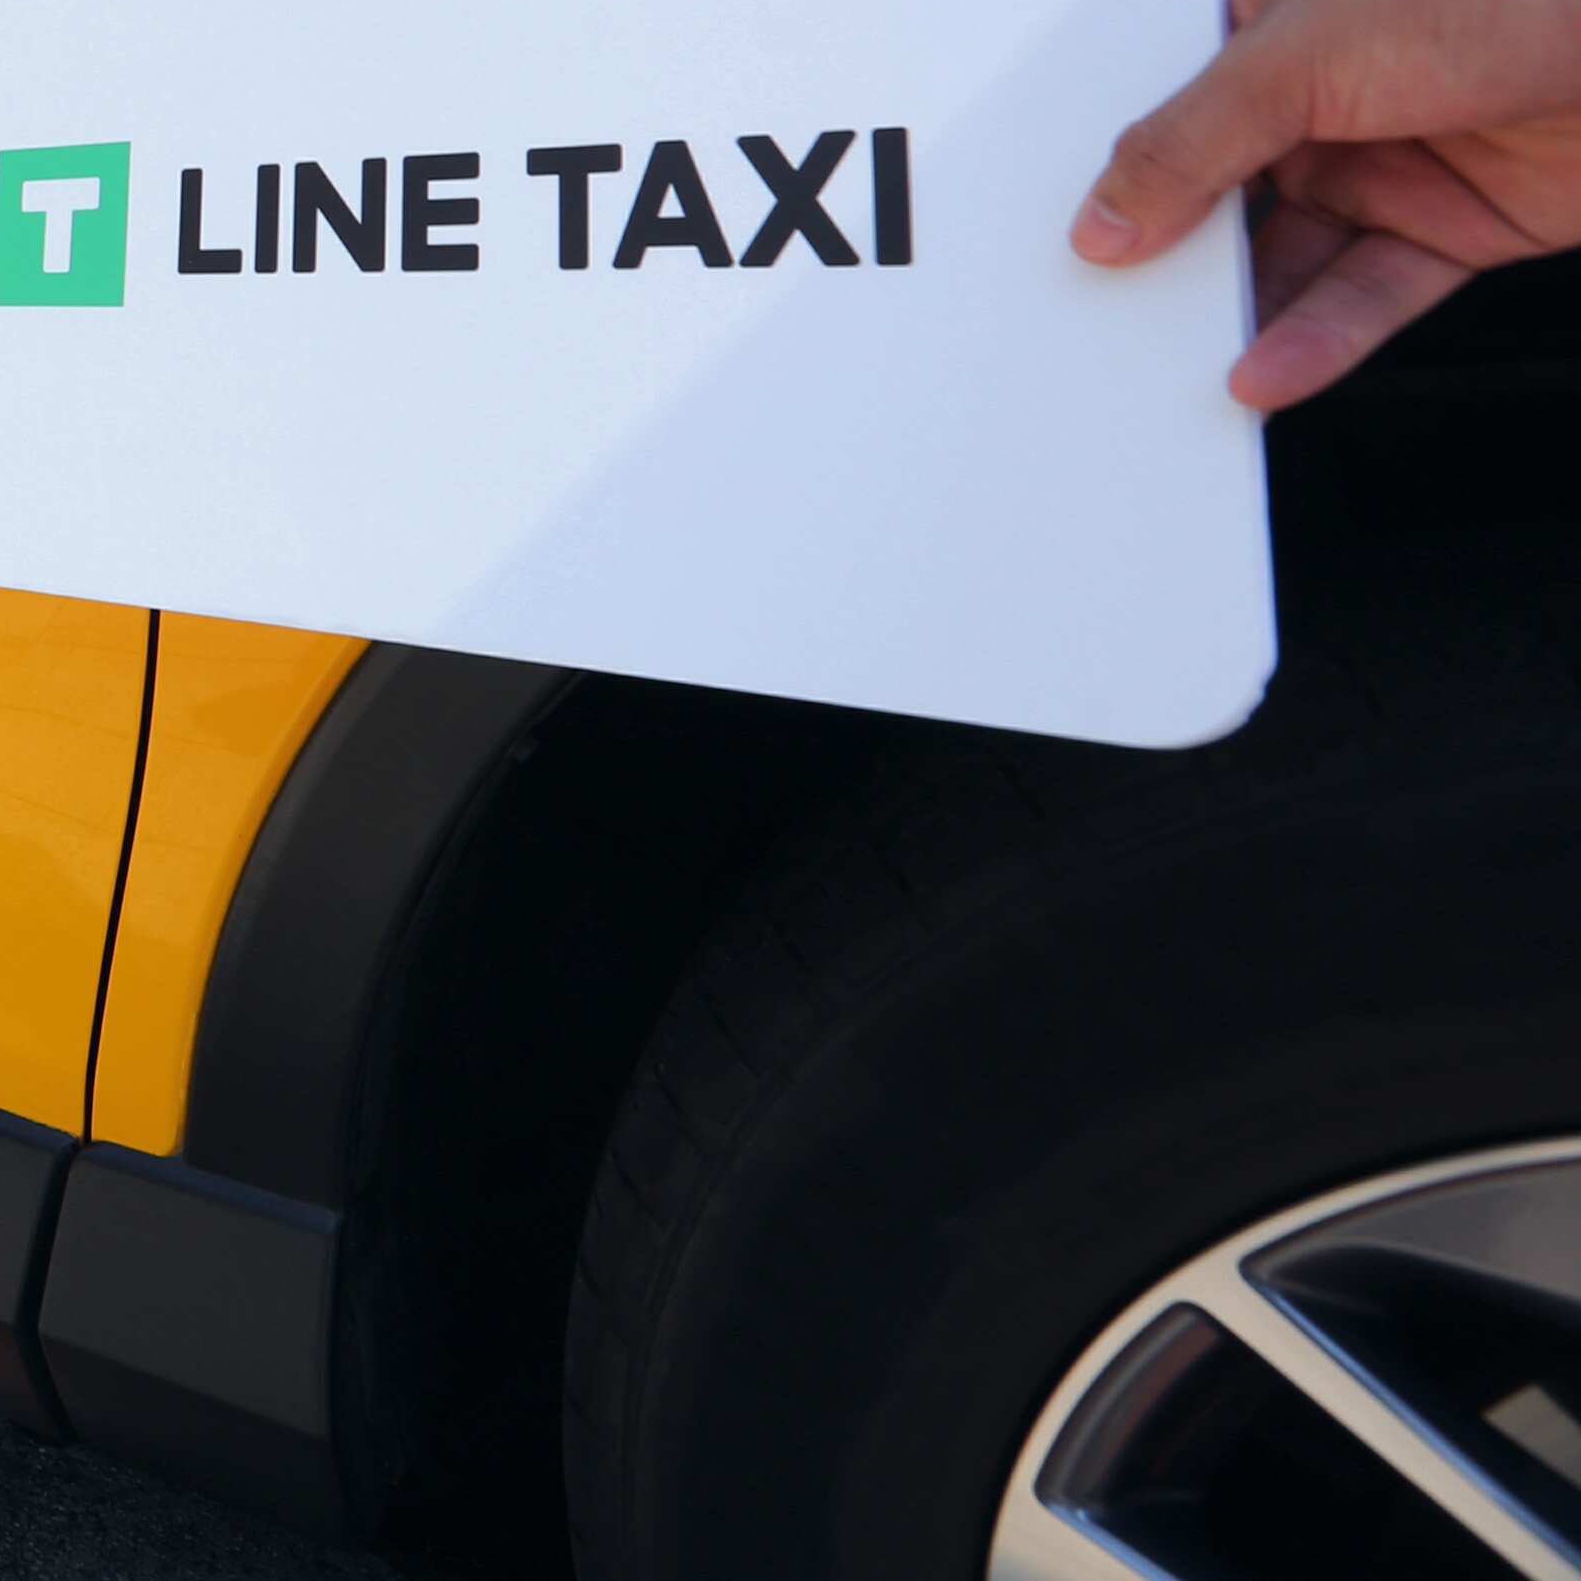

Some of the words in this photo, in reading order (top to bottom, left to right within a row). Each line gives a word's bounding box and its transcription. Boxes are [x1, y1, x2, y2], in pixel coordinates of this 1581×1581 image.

[21, 176, 101, 274] T
[177, 152, 480, 275] LINE
[526, 126, 913, 270] TAXI
